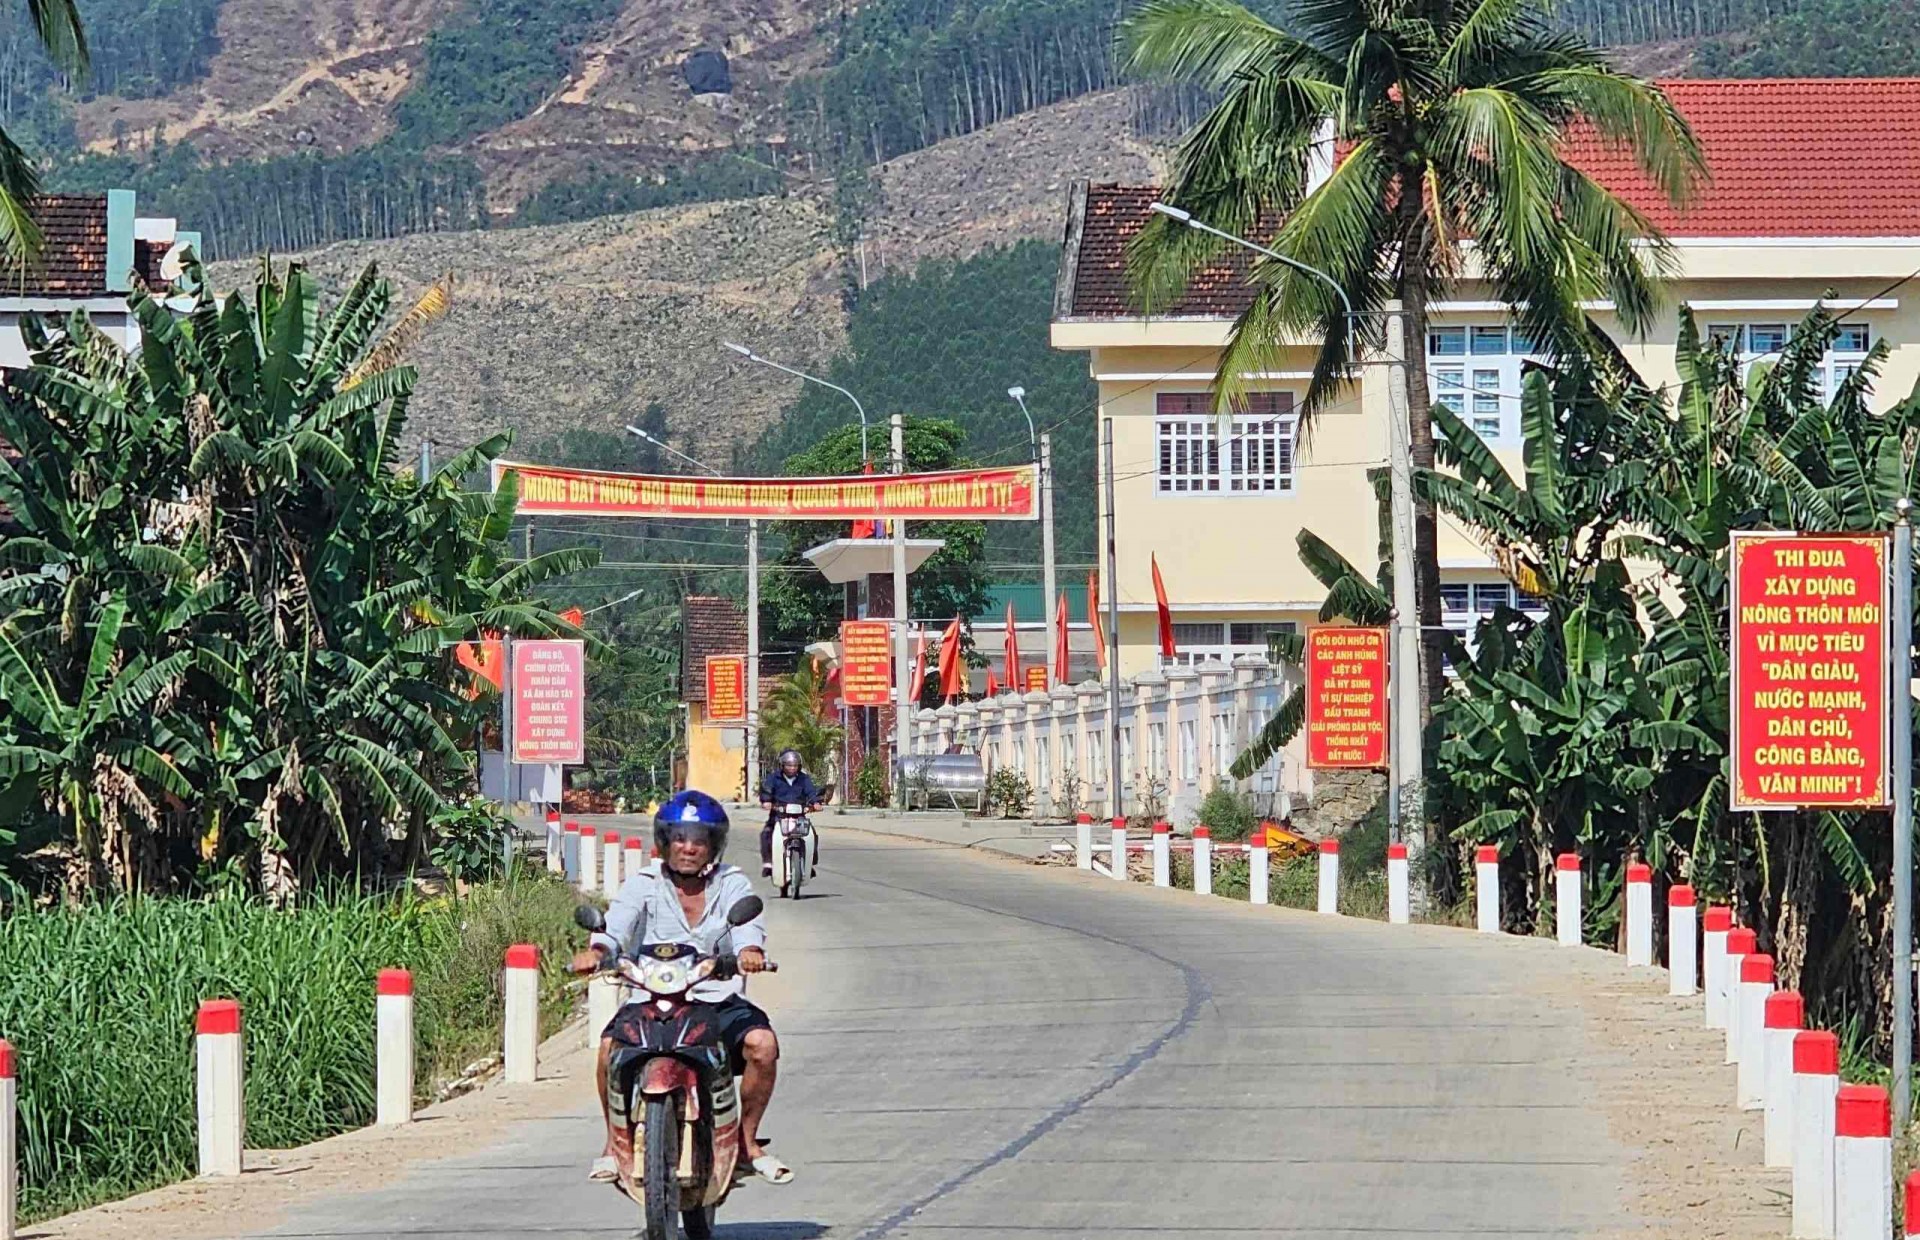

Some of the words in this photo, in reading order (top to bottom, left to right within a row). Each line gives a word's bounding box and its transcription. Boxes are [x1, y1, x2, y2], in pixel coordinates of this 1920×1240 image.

[524, 473, 566, 503] MỪNG
[792, 484, 839, 510] QUANG
[842, 483, 880, 511] VINH,
[884, 479, 925, 508] MỪNG
[929, 478, 967, 508] XUÂN
[971, 475, 988, 508] ẤT
[992, 482, 1012, 512] TỴ!
[1774, 550, 1804, 567] THI
[1809, 550, 1845, 567] ĐUA
[1765, 574, 1801, 595] XÂY
[1806, 575, 1855, 600] DỰNG
[1742, 603, 1791, 623] NÔNG
[1796, 603, 1842, 623] THÔN
[1848, 602, 1879, 623] MỚI
[1757, 630, 1775, 652] VÌ
[1780, 635, 1818, 656] MỤC
[1824, 632, 1865, 652] TIÊU
[1762, 659, 1806, 680] "DÂN
[1811, 659, 1859, 683] GIÀU,
[1755, 688, 1804, 708] NƯỚC
[1809, 692, 1867, 713] MẠNH,
[1768, 716, 1805, 736] DÂN
[1810, 713, 1852, 740] CHỦ,
[1755, 744, 1805, 765] CÔNG
[1810, 741, 1865, 768] BẰNG,
[1759, 773, 1796, 793] VĂN
[1801, 776, 1861, 793] MINH"!
